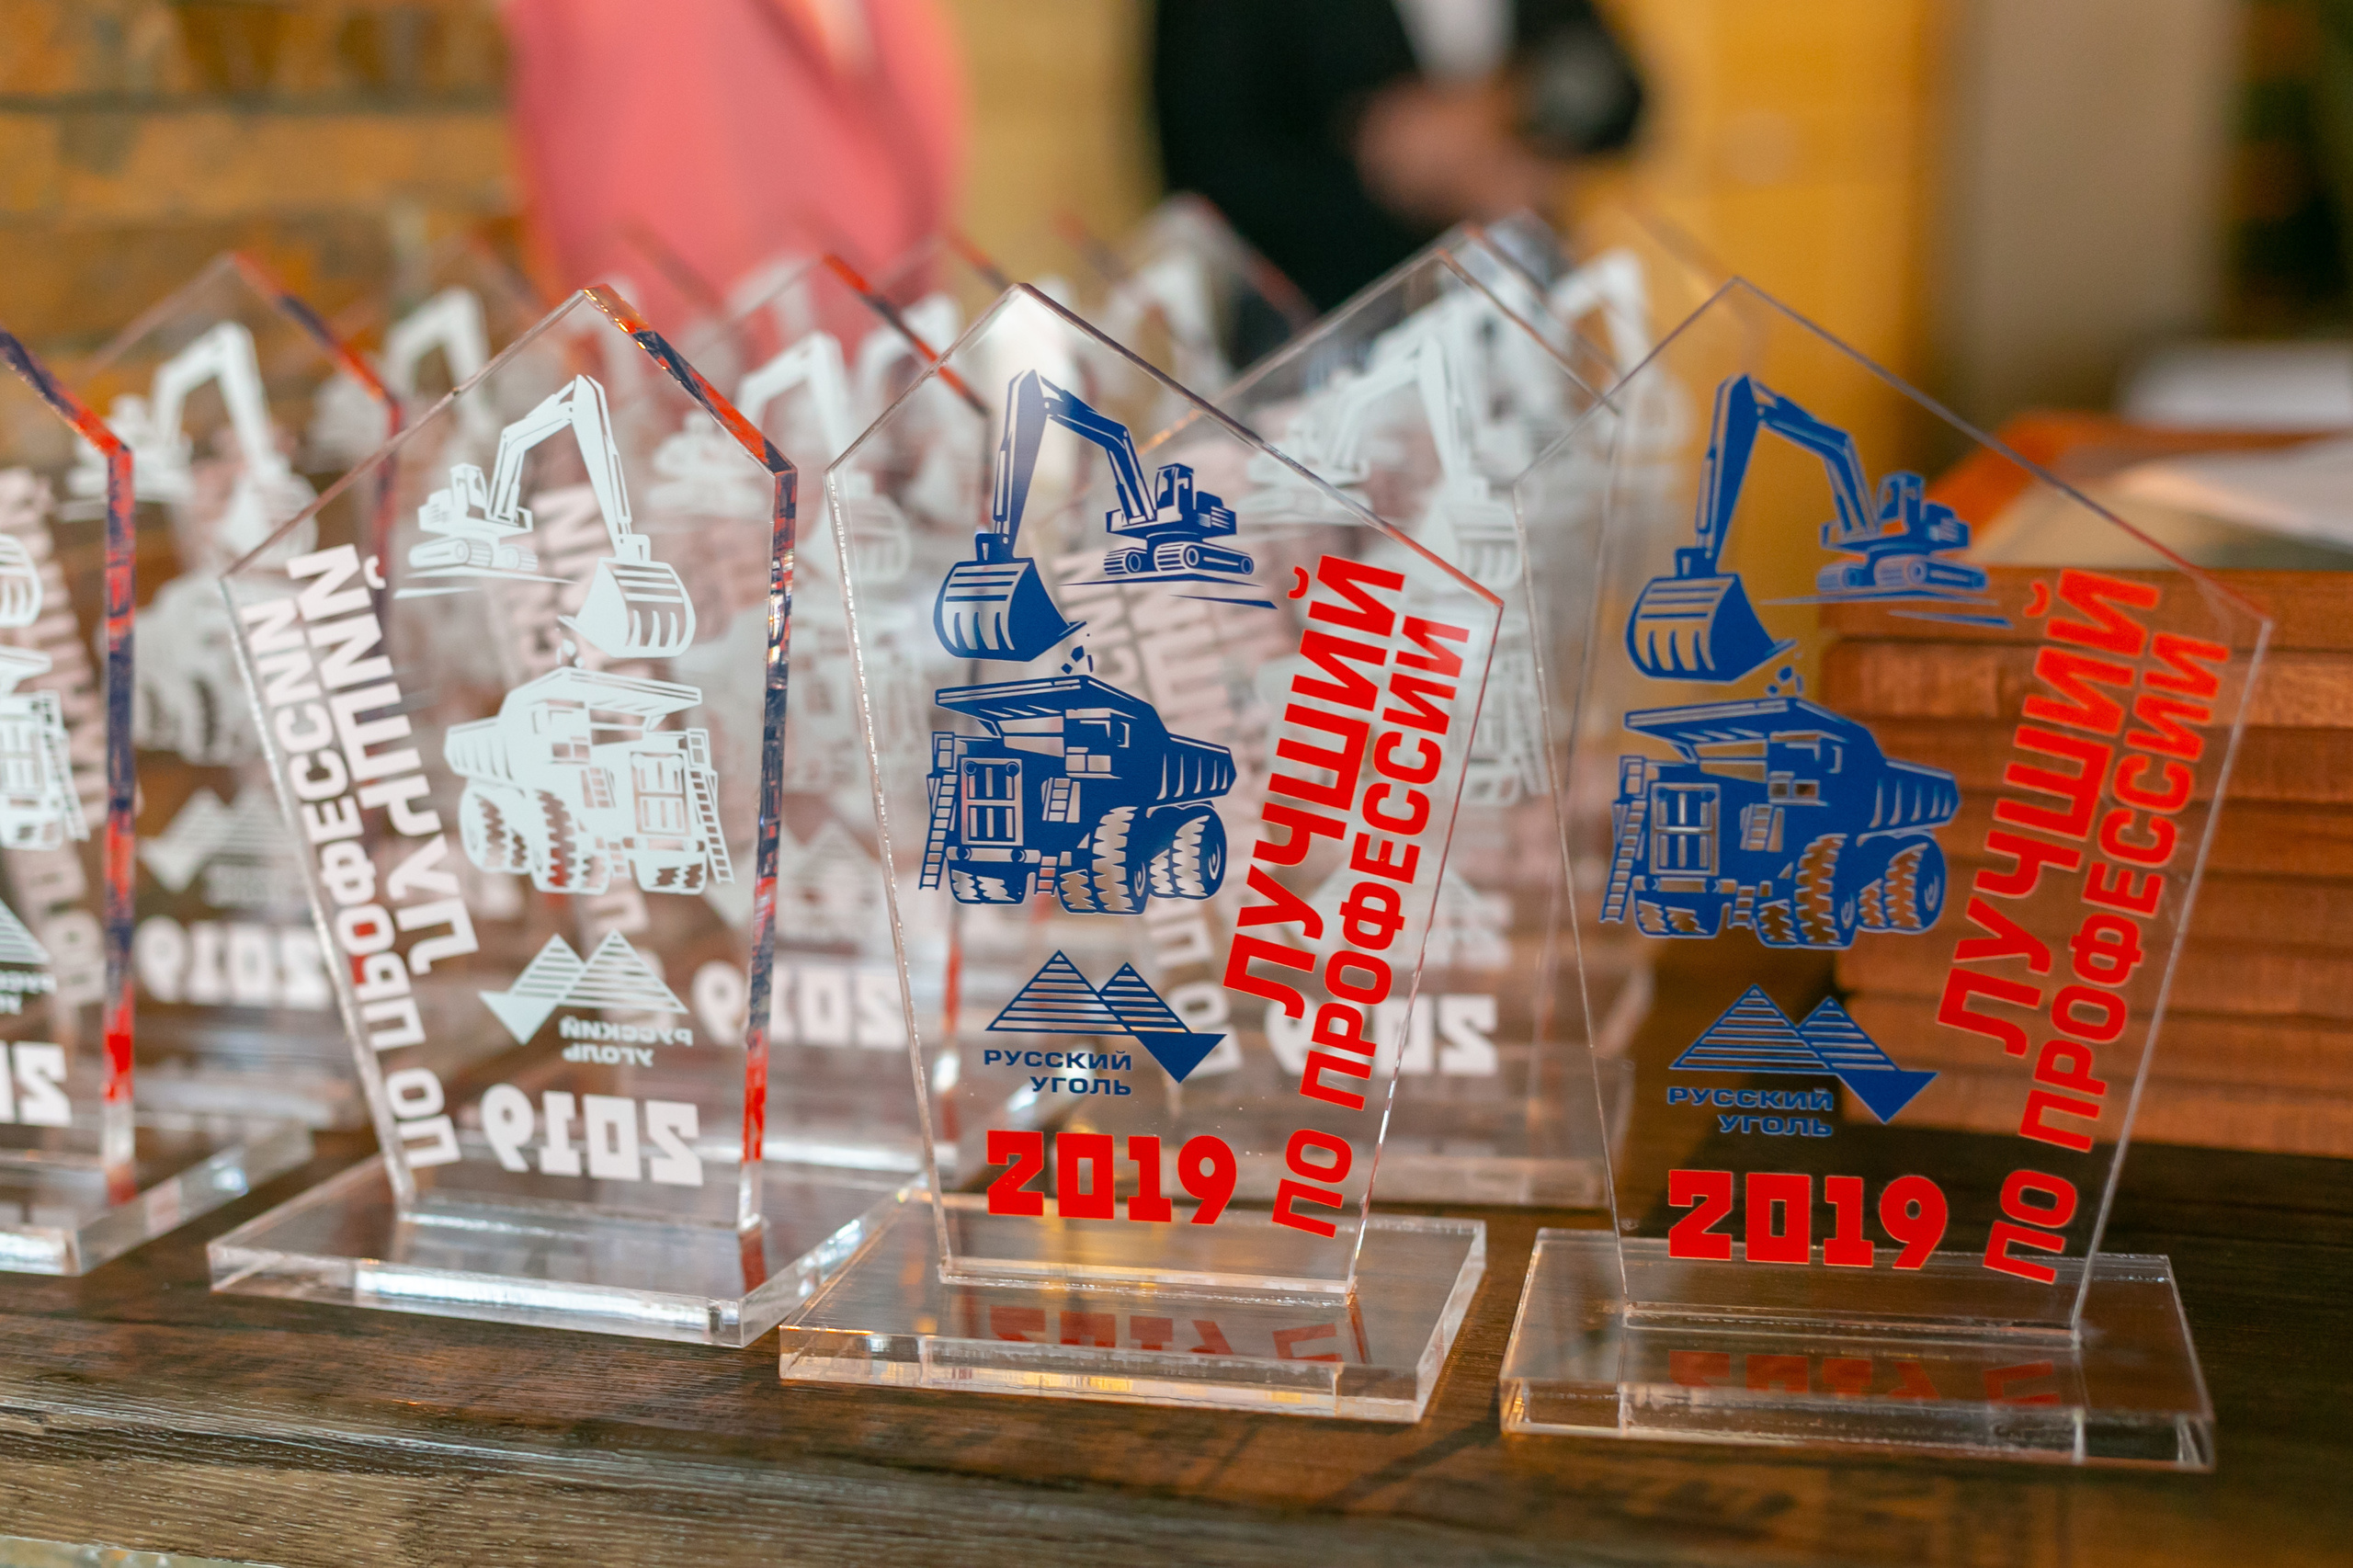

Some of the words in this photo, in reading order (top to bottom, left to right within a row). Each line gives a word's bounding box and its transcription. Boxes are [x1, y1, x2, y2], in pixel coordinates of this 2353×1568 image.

[1223, 554, 1405, 1020] ЛУЧШИЙ
[1937, 568, 2160, 1056] ЛУЧШИЙ
[1299, 615, 1471, 1111] ПРОФЕССИИ
[2018, 632, 2229, 1153] ПРОФЕССИИ
[983, 1050, 1131, 1071] РУССКИЙ
[1030, 1076, 1131, 1096] УГОЛЬ
[1667, 1086, 1834, 1111] РУССКИЙ
[986, 1130, 1237, 1225] 2019
[1719, 1114, 1833, 1137] УГОЛЬ
[1271, 1129, 1353, 1239] ПО
[1668, 1168, 1948, 1269] 2019
[1983, 1169, 2077, 1284] ПО
